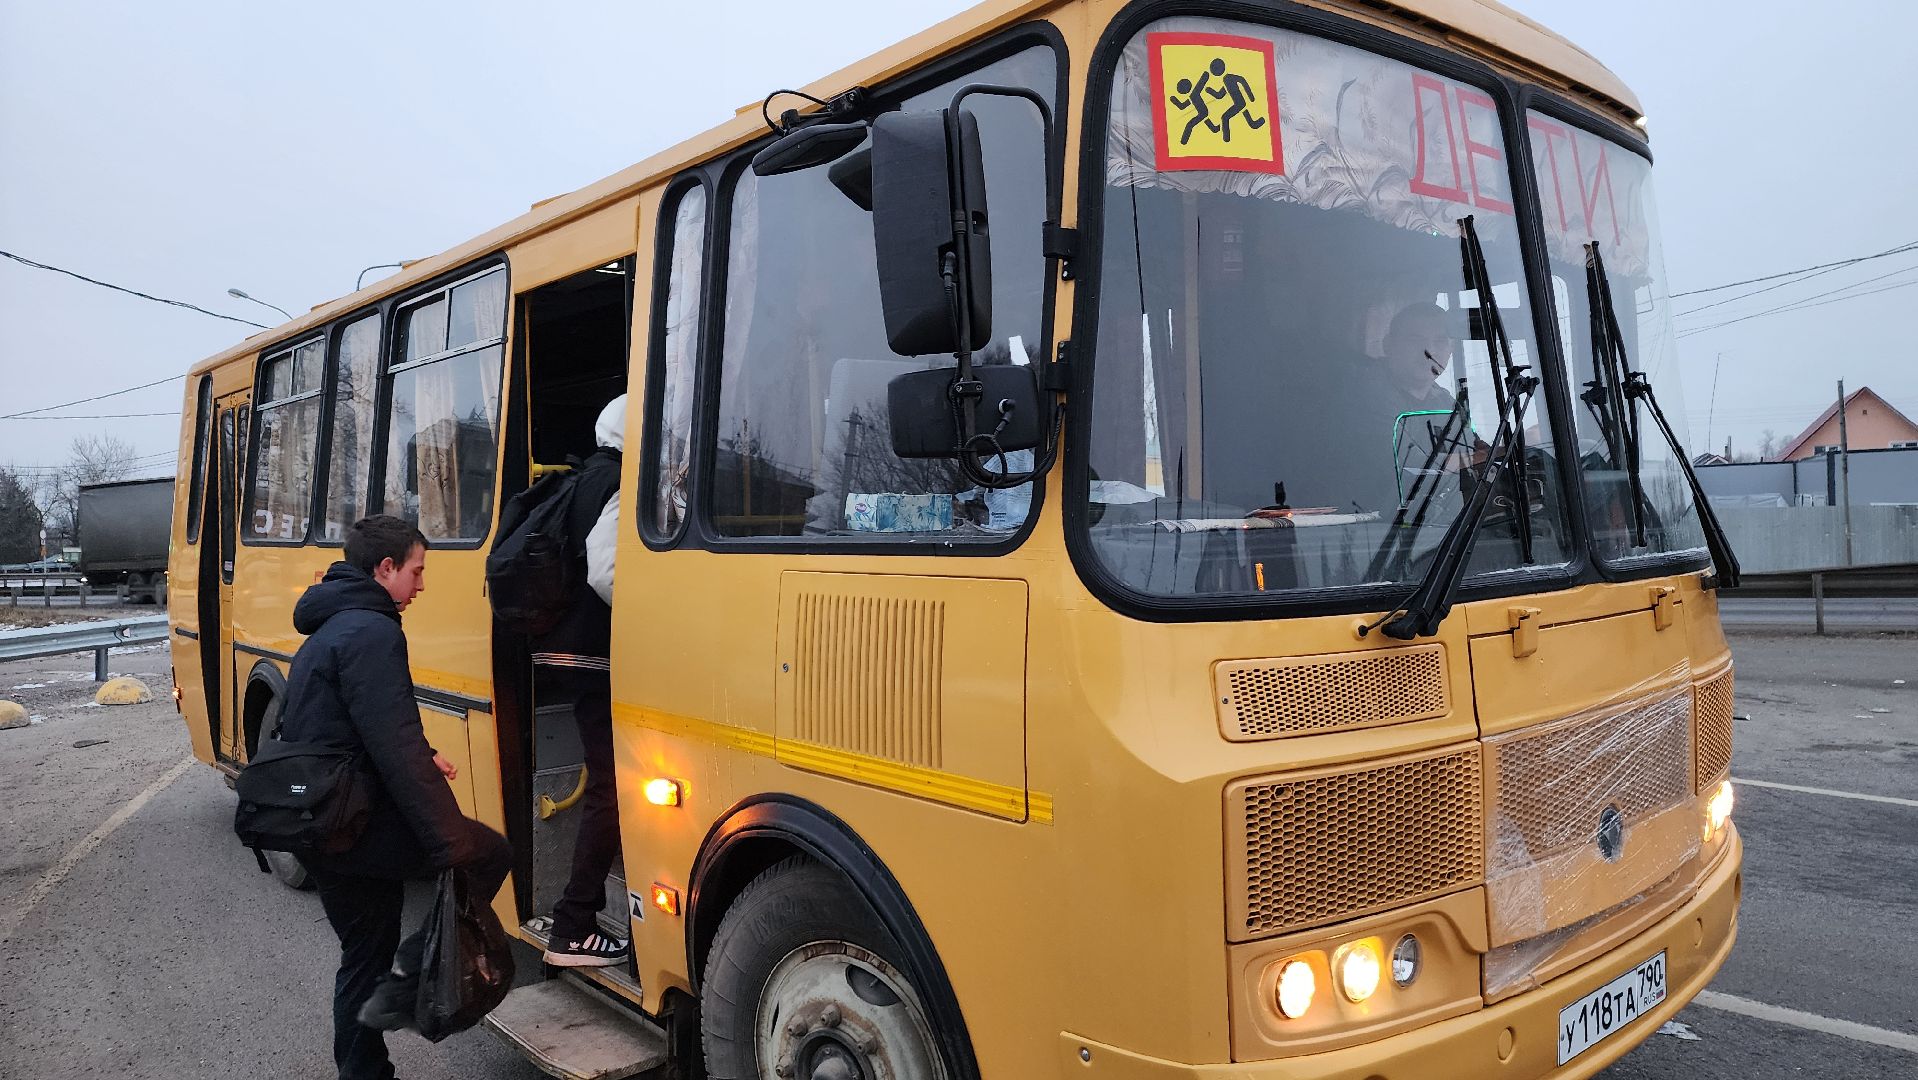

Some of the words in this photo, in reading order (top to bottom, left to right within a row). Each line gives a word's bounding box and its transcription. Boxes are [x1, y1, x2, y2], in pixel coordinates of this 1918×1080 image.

[1409, 73, 1621, 246] ДЕТИ
[1638, 959, 1661, 998] 790
[1643, 991, 1656, 1007] RUS
